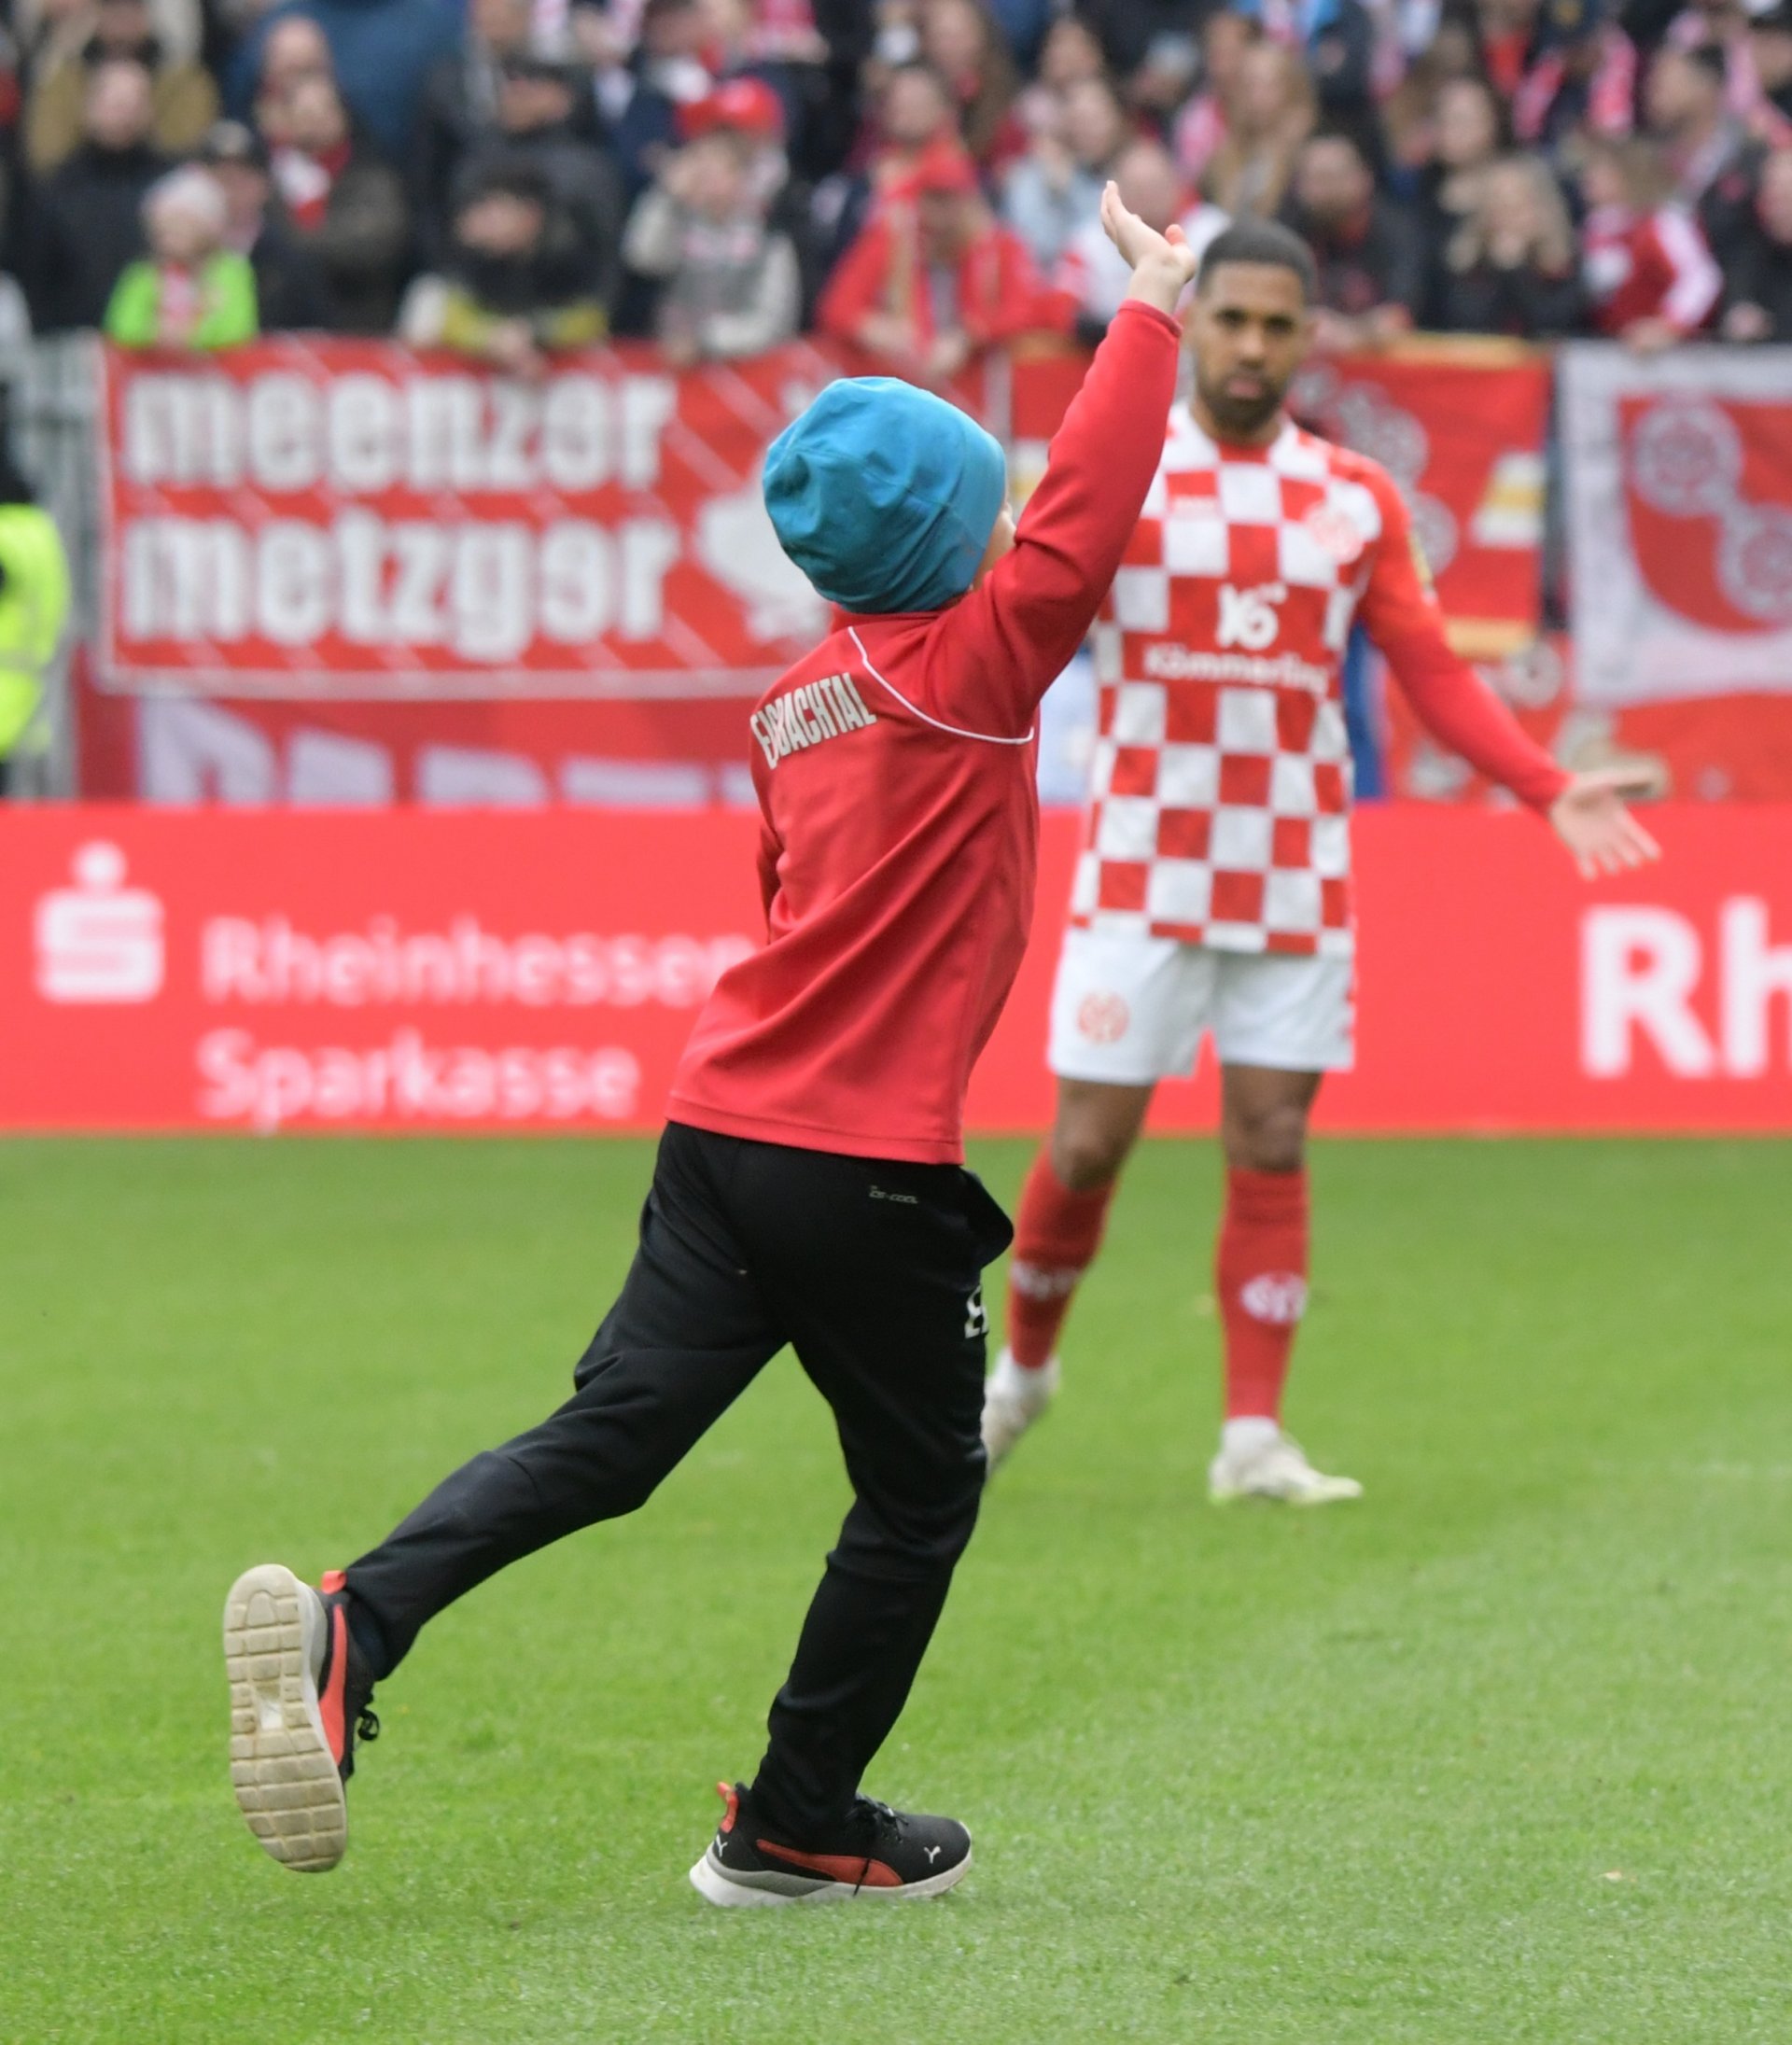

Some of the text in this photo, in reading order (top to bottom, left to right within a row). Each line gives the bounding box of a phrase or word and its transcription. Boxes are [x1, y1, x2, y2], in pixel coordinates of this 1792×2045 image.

[120, 372, 674, 492] meenzer
[119, 509, 677, 662] metzger
[197, 1027, 640, 1134] Sparkasse
